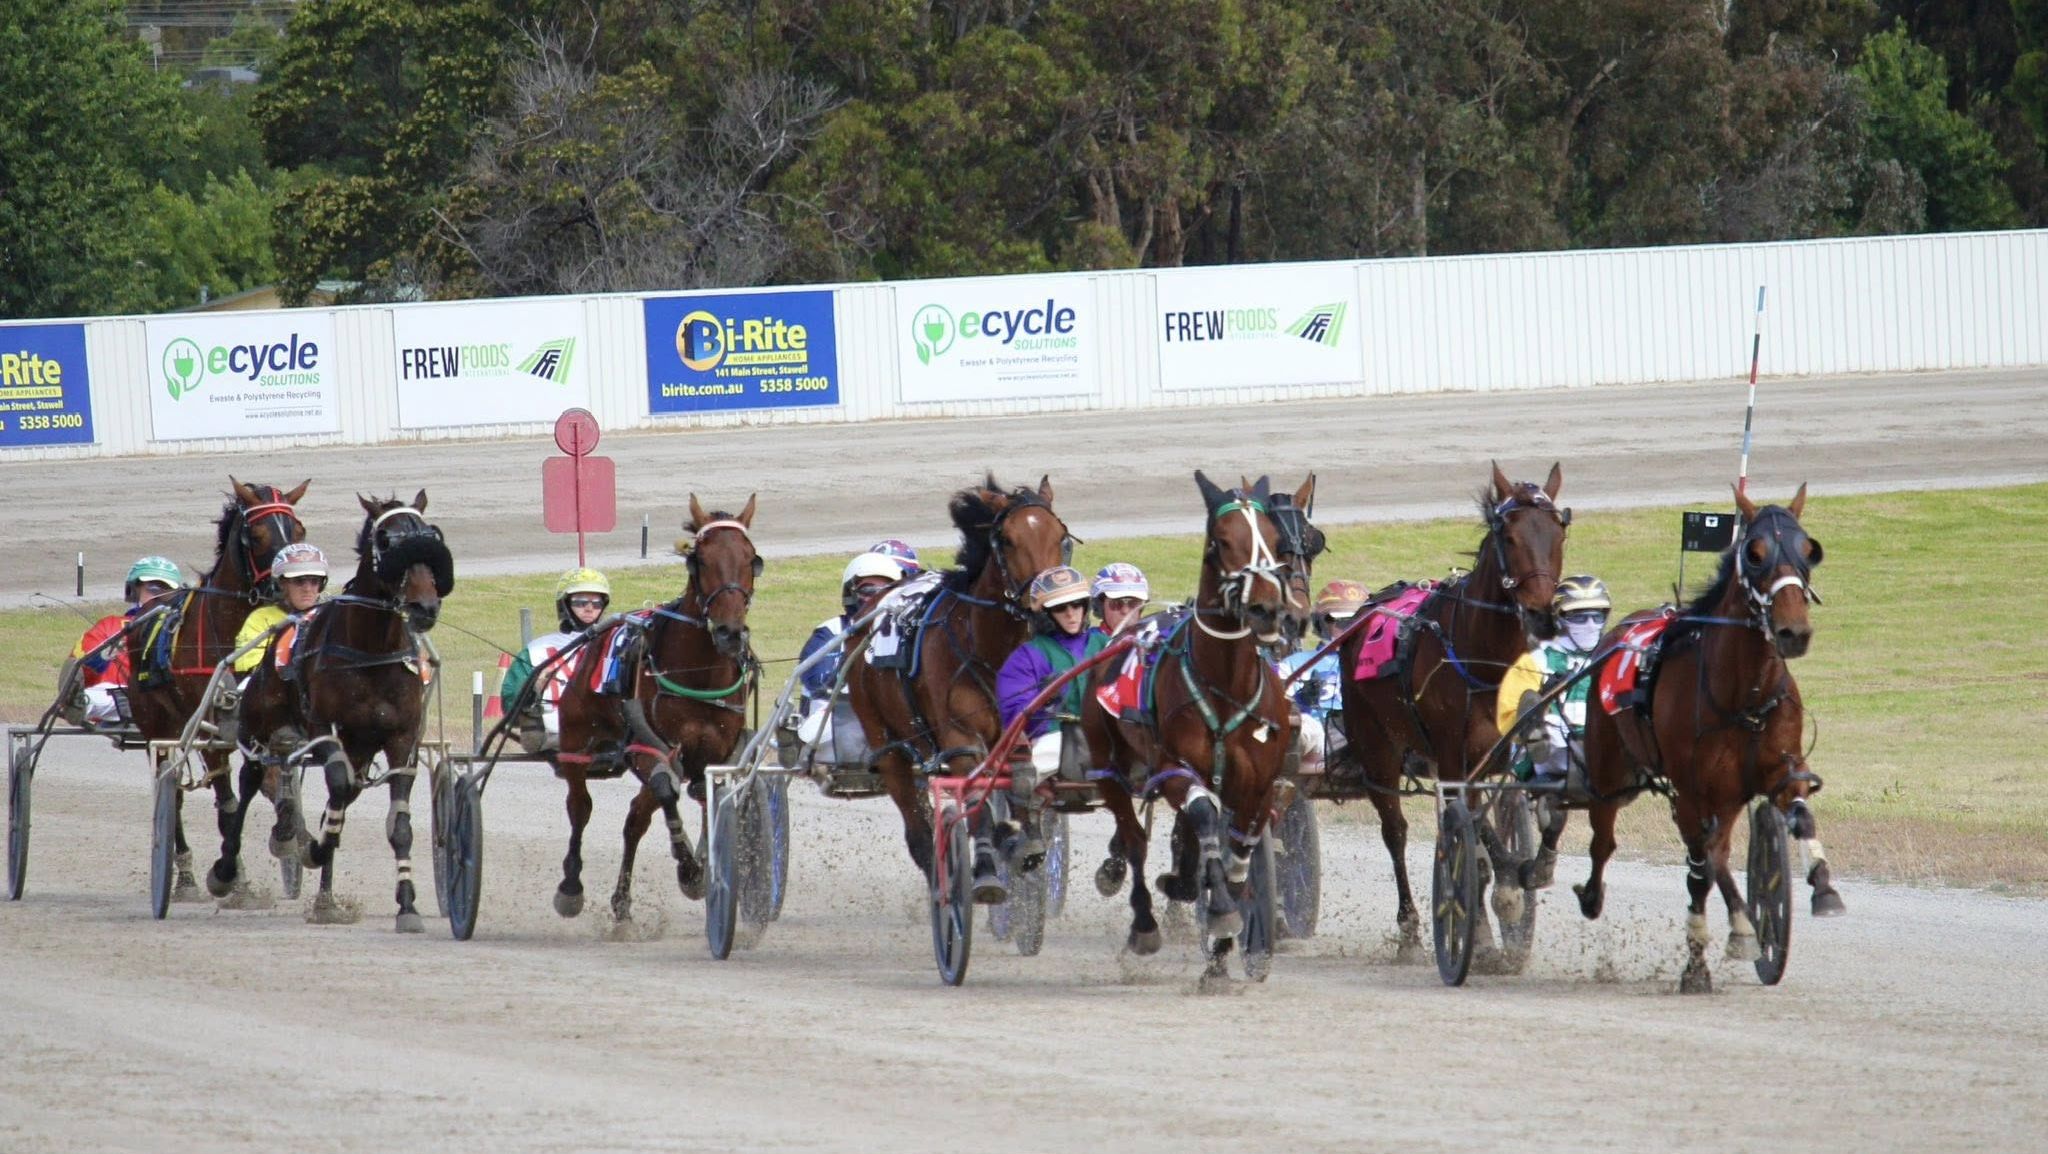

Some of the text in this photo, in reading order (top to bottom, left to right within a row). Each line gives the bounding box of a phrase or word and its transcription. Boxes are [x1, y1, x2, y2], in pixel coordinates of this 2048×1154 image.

[959, 299, 1076, 345] ecycle
[1165, 308, 1278, 342] FREW FOODS
[682, 317, 807, 362] Bi-Rite
[1014, 337, 1077, 350] SOLUTIONS
[207, 333, 319, 381] ecycle
[402, 343, 510, 380] FREW FOODS
[733, 352, 802, 364] HOME APPLIANCES
[0, 350, 61, 385] Rite
[715, 368, 730, 378] 141
[731, 367, 751, 377] Main
[260, 372, 321, 387] SOLUTIONS
[760, 376, 828, 393] 5358 5000
[209, 394, 235, 403] Ewaste
[243, 391, 286, 402] Polystyrene
[286, 389, 322, 400] Recycling
[661, 382, 744, 397] birite.com.au
[19, 415, 50, 430] 5358
[52, 412, 82, 428] 5000
